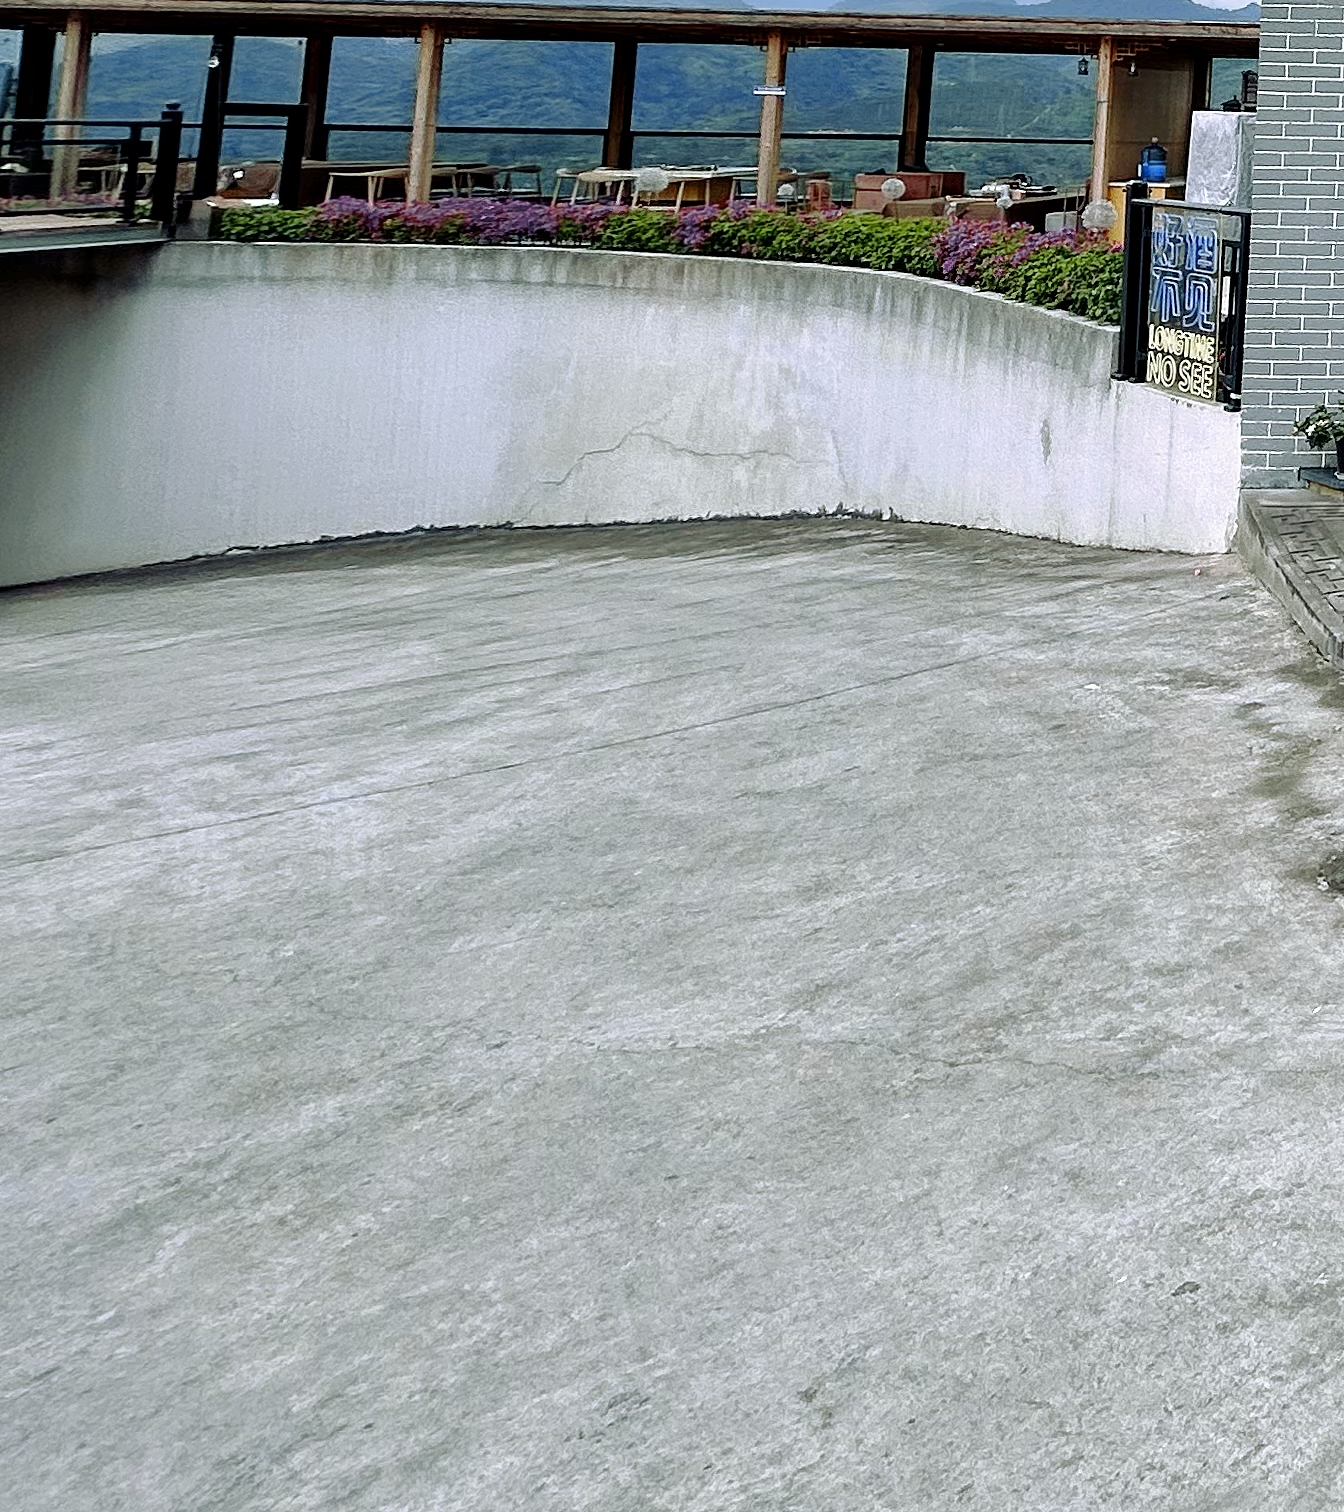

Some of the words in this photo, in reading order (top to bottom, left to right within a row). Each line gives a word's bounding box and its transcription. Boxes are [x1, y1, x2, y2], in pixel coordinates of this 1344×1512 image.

[1152, 213, 1218, 275] 好酒
[1151, 266, 1216, 333] 不见
[1146, 350, 1178, 388] NO
[1178, 358, 1214, 400] SEE
